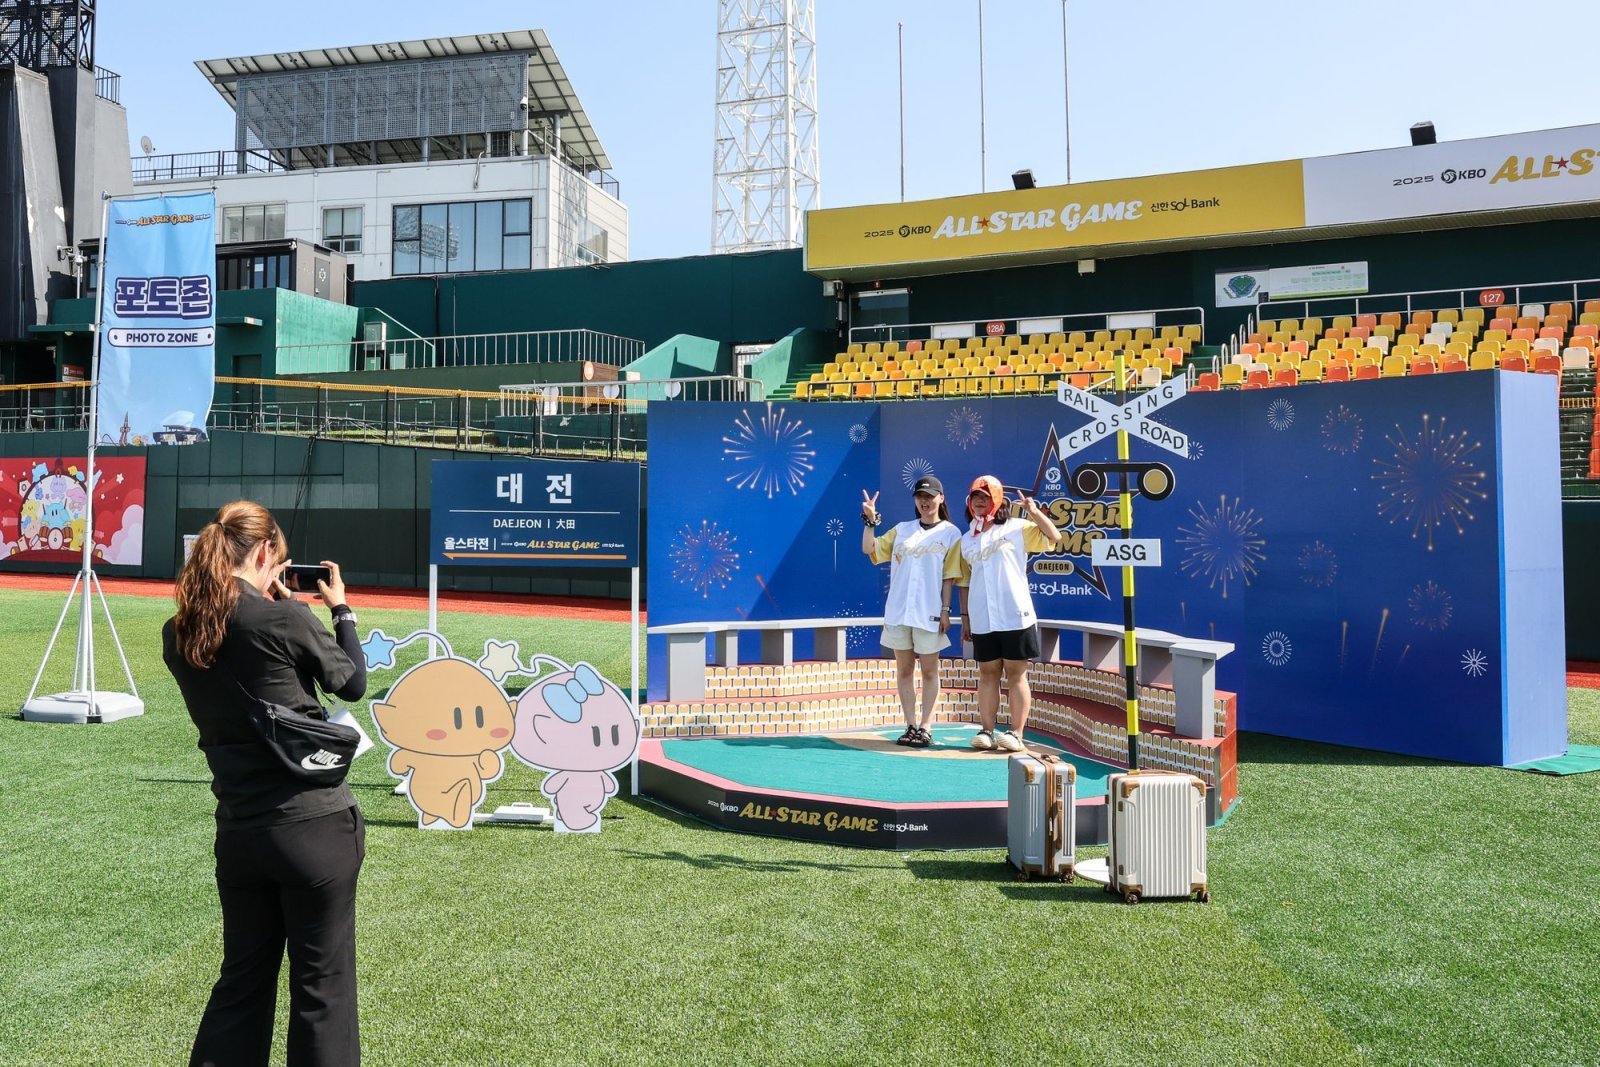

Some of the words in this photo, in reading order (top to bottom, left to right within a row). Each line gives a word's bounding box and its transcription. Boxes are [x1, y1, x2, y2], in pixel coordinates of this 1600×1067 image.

[1393, 175, 1434, 186] 2025
[1458, 168, 1487, 180] KBO
[863, 230, 894, 238] 2025
[911, 225, 932, 235] KBO
[1060, 200, 1143, 232] GAME
[1150, 202, 1169, 213] 신한
[1191, 197, 1220, 209] Bank
[114, 276, 212, 320] 포토존
[1483, 293, 1501, 303] 127
[126, 333, 166, 343] PHOTO
[167, 333, 198, 343] ZONE
[1064, 389, 1099, 413] RAIL
[1140, 421, 1184, 449] ROAD
[1069, 386, 1173, 449] CROSSING
[493, 518, 542, 529] DAEJEON
[555, 518, 576, 530] 大田
[444, 537, 489, 551] 올스타전
[571, 540, 600, 551] GAME
[1106, 544, 1147, 561] ASG
[1038, 562, 1070, 571] DAEJEON
[1061, 584, 1093, 596] Bank
[310, 748, 343, 766] NIKE
[724, 805, 739, 813] KBO
[823, 811, 880, 832] GAME
[909, 823, 929, 832] Bank
